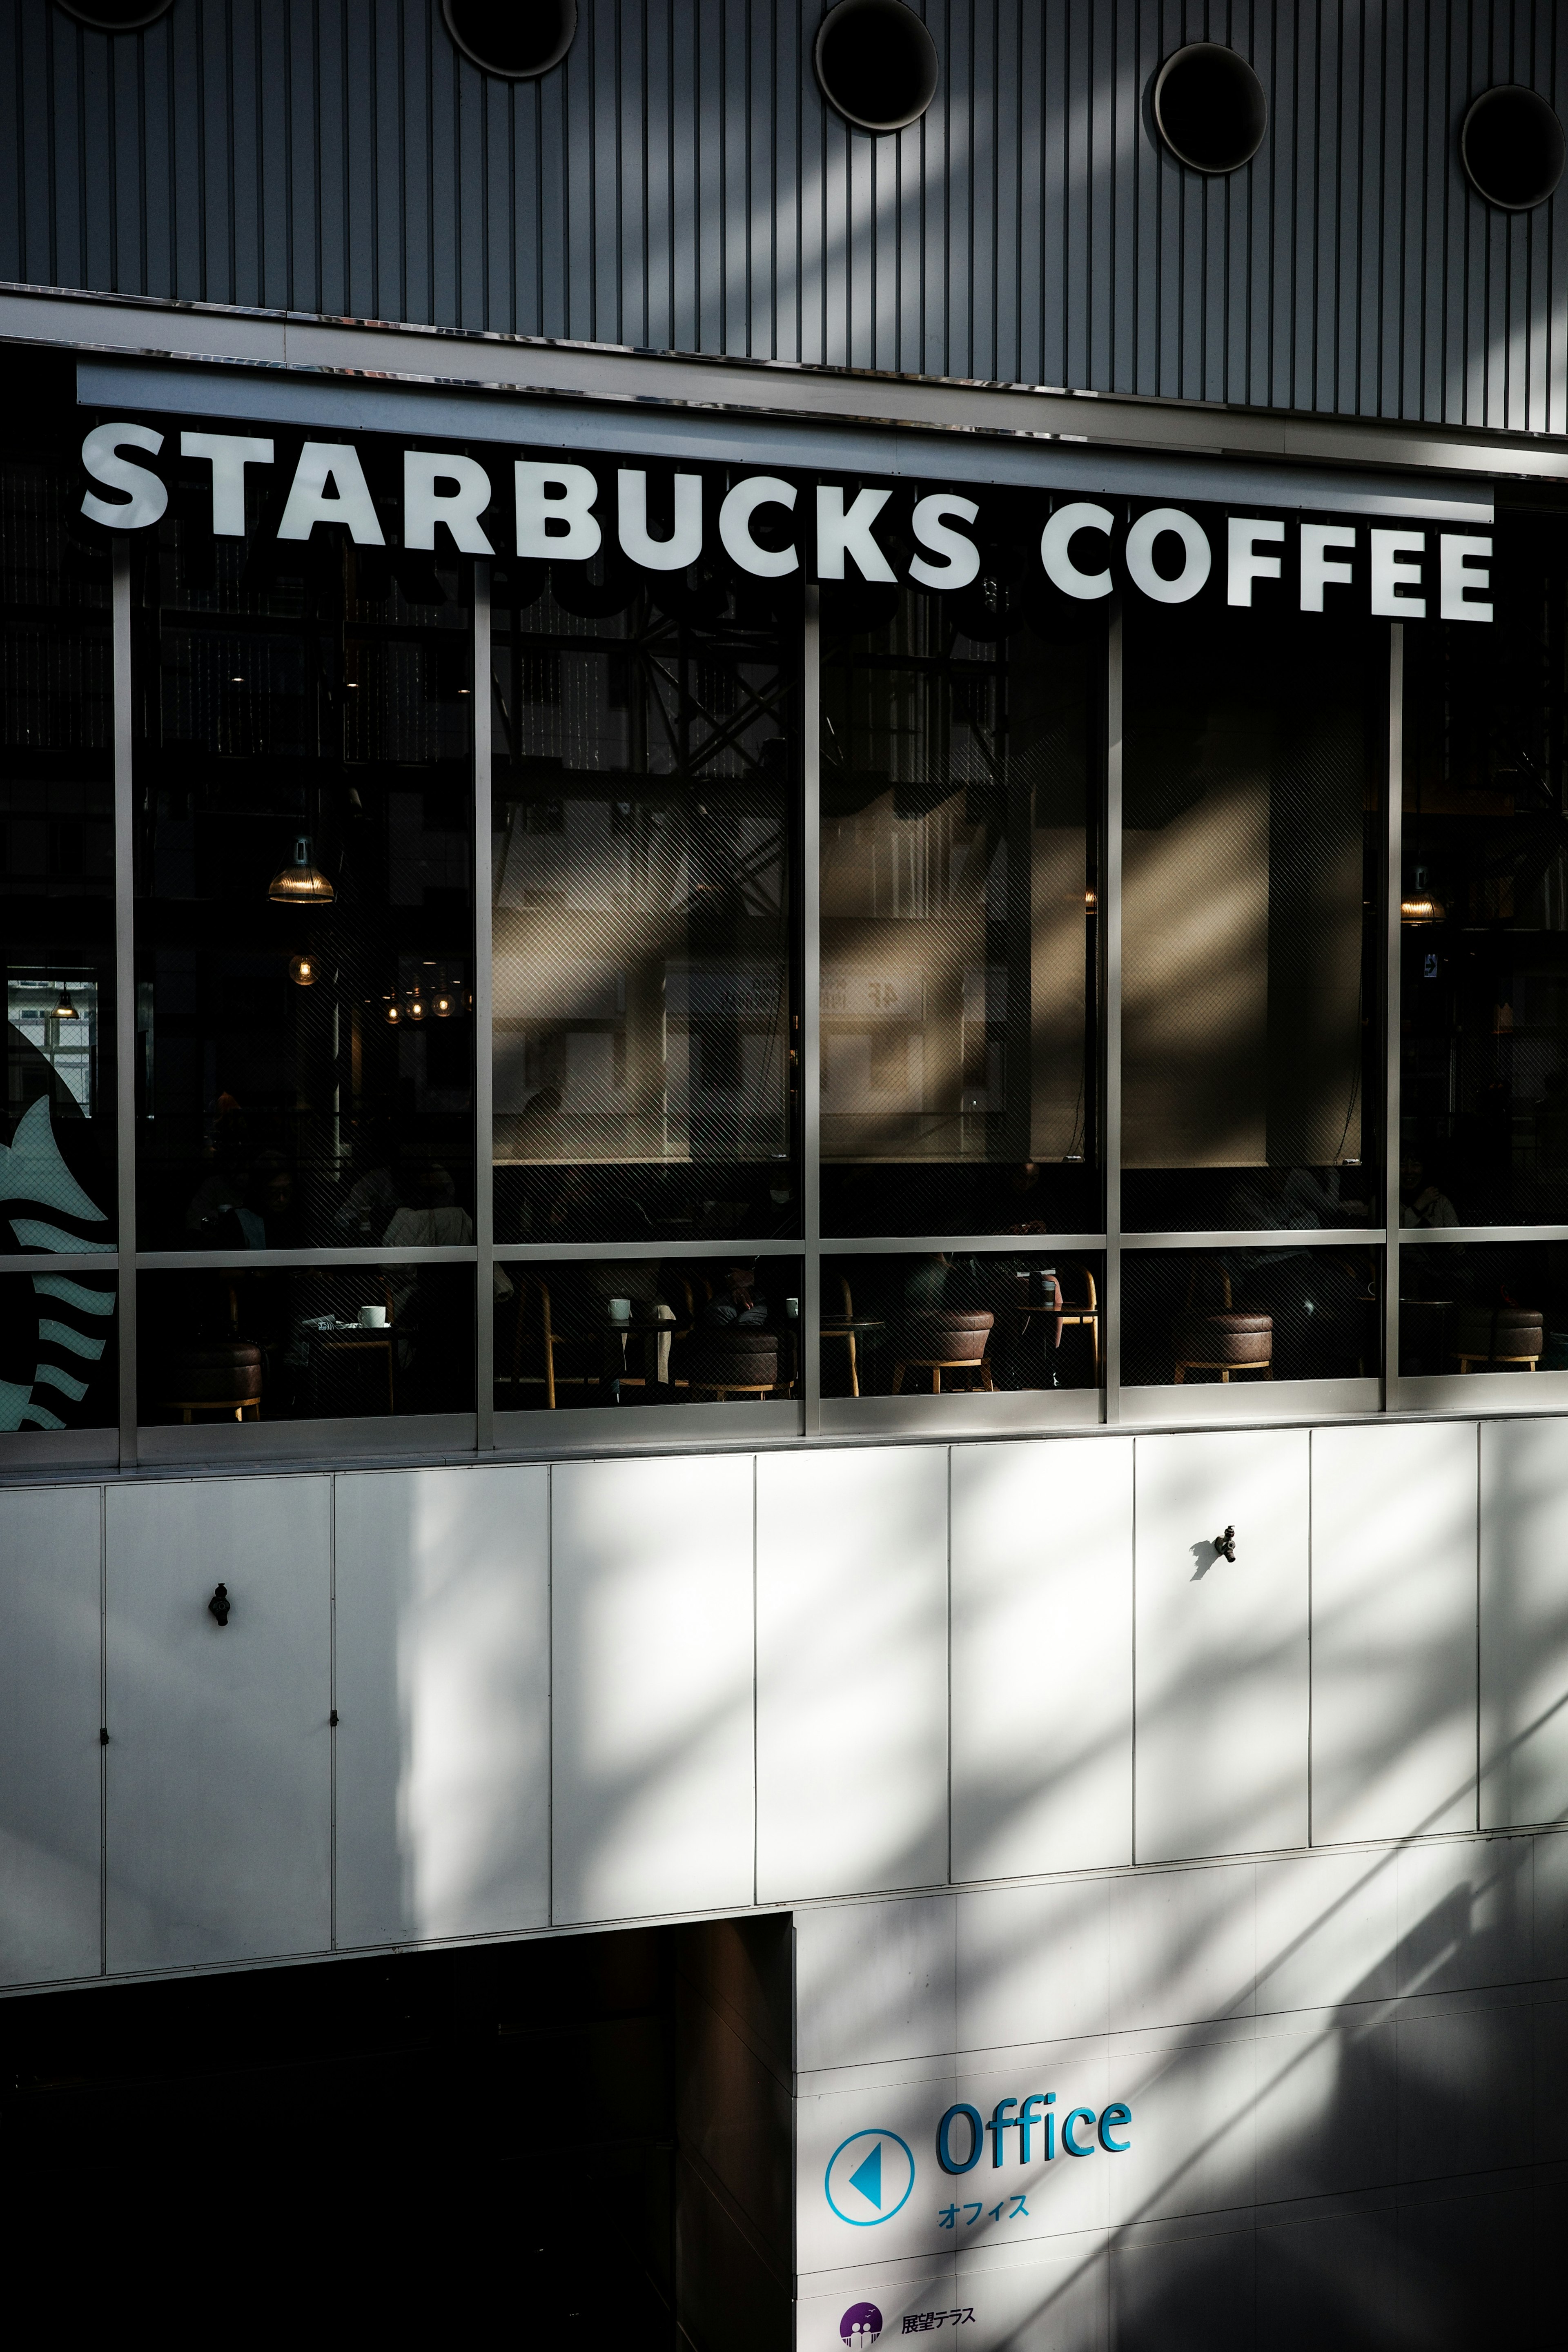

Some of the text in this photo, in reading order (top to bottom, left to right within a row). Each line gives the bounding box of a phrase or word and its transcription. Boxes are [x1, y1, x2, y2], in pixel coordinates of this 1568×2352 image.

[80, 422, 1494, 622] STARBUCKS COFFEE
[937, 2092, 1132, 2174] Office
[938, 2195, 1029, 2229] オフィス
[901, 2307, 976, 2335] 展望テラス
